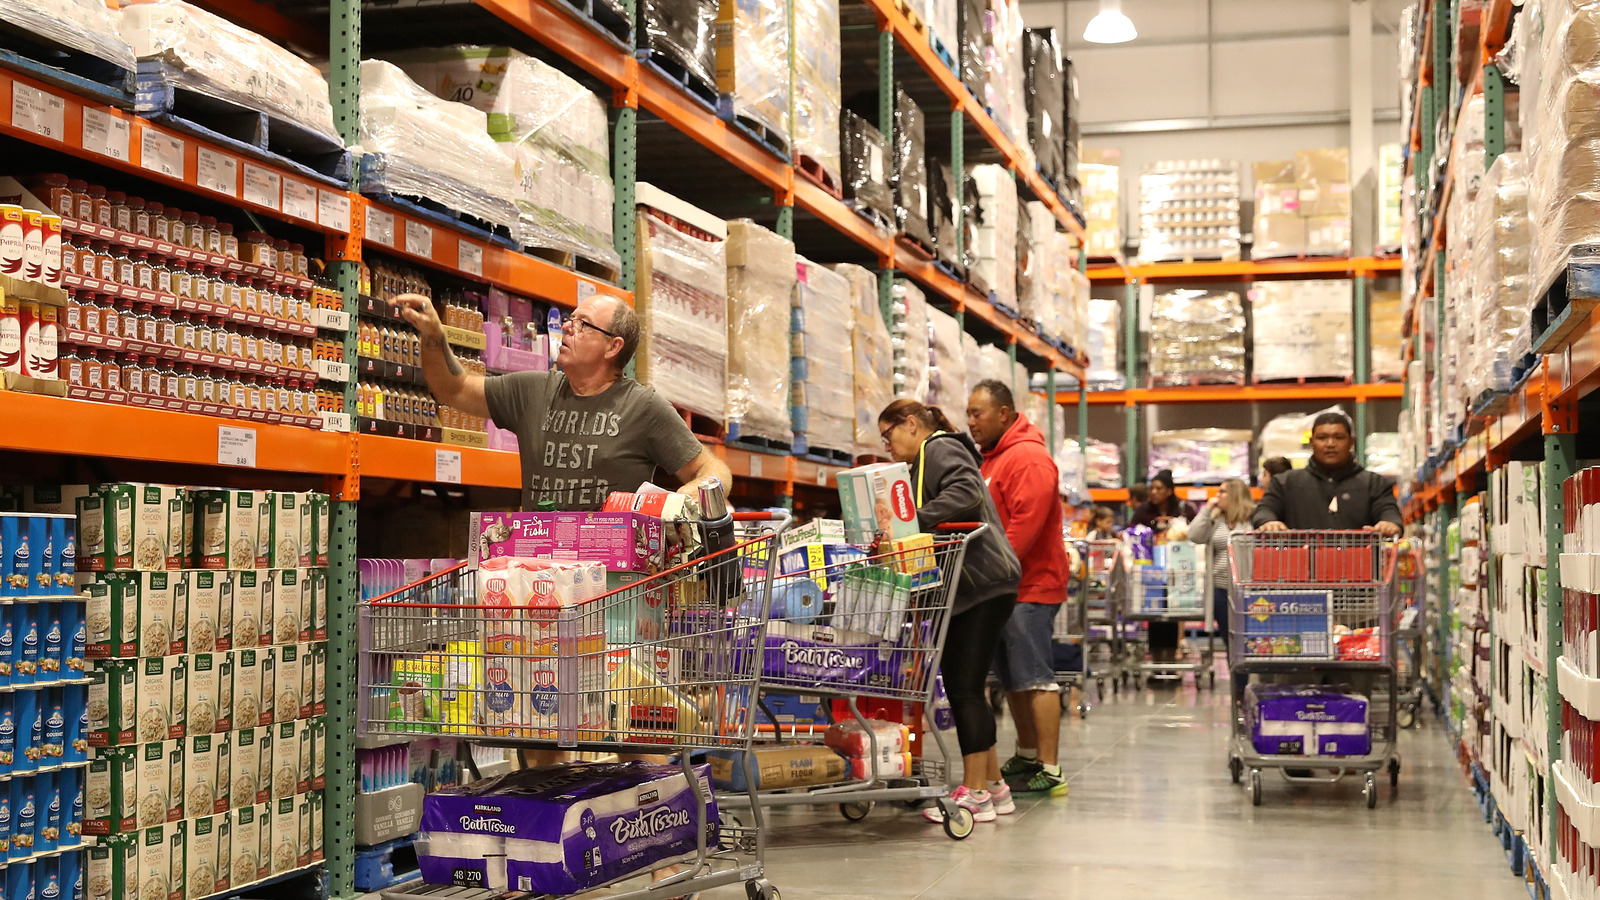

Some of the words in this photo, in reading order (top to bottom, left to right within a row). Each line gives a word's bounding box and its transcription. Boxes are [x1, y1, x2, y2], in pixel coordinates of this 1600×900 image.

[541, 406, 622, 437] WORLD'S
[543, 441, 599, 470] BEST
[531, 474, 609, 505] FARTER
[142, 513, 161, 521] CHICKEN
[523, 522, 549, 538] Fishy
[783, 525, 817, 546] VitaFresh
[784, 553, 805, 573] VIVA
[488, 579, 504, 592] LION
[534, 581, 553, 596] LION
[1279, 601, 1299, 614] 66
[144, 684, 163, 692] CHICKEN
[237, 755, 254, 763] CHICKEN
[790, 759, 813, 768] PLAIN
[192, 761, 211, 769] CHICKEN
[144, 769, 163, 777] CHICKEN
[791, 769, 813, 778] FLOUR
[474, 804, 502, 812] KIRKLAND
[373, 820, 394, 831] VANILLA
[237, 832, 254, 840] CHICKEN
[145, 854, 164, 863] CHICKEN
[453, 870, 464, 880] 48
[466, 870, 482, 881] 270
